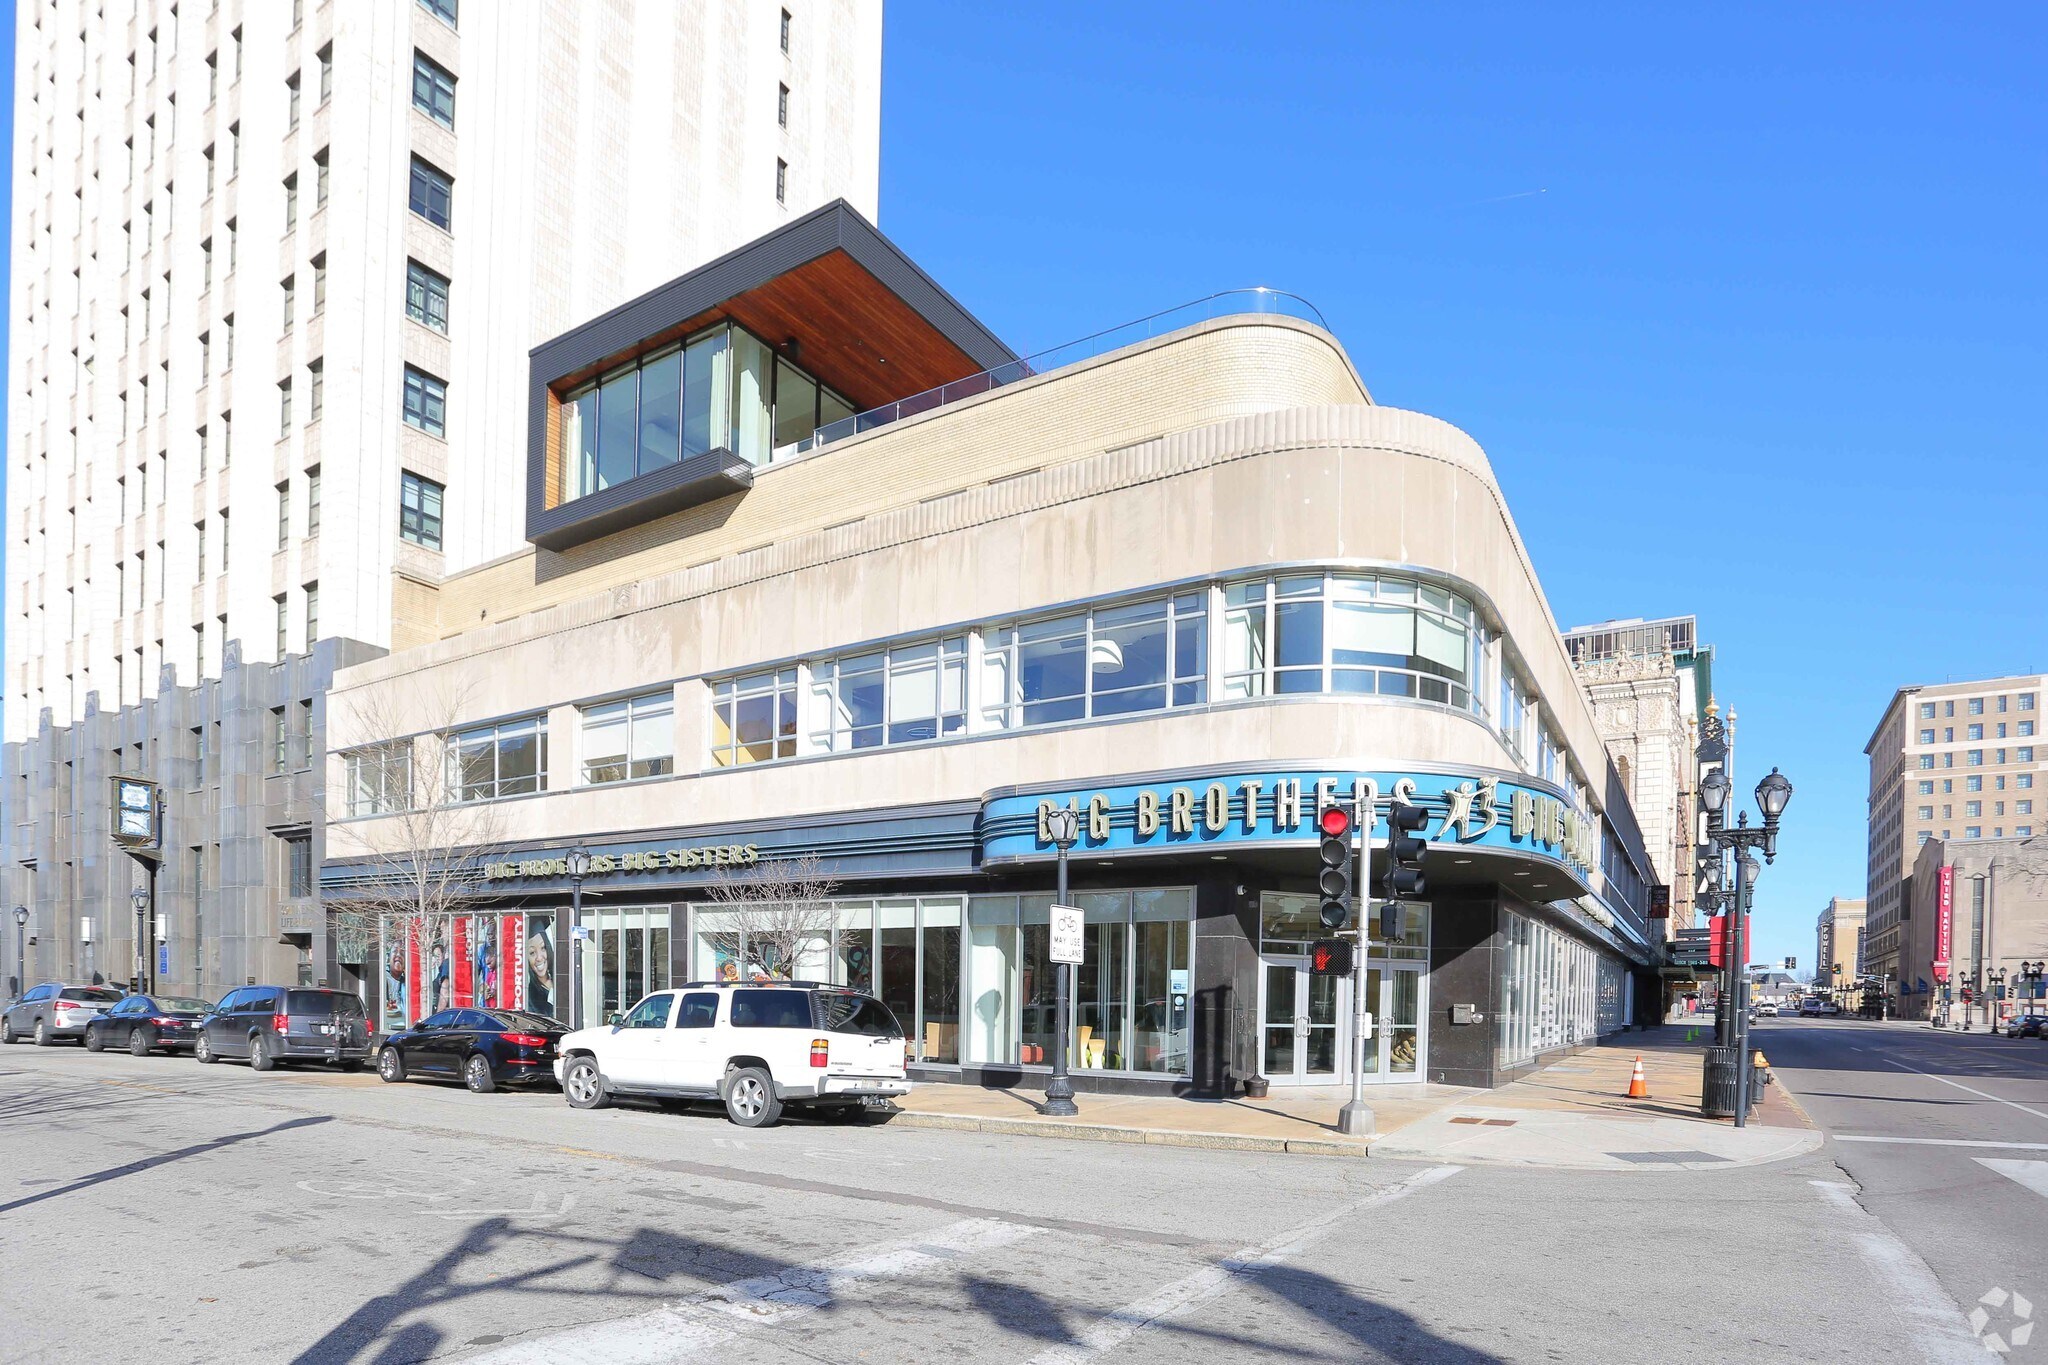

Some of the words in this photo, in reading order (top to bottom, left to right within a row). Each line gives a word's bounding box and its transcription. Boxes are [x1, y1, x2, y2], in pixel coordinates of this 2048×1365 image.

[1038, 793, 1110, 842] BIG
[1513, 790, 1564, 845] BIG
[484, 861, 516, 879] BIG
[519, 854, 615, 877] BROTRS
[622, 850, 660, 871] BIG
[665, 843, 758, 868] SISTERS
[465, 919, 473, 962] HOPE
[1053, 947, 1066, 956] FULL
[1069, 950, 1081, 958] LANE
[1054, 936, 1066, 944] MAY
[1070, 938, 1080, 946] USE
[514, 917, 523, 1010] PORTUNITY
